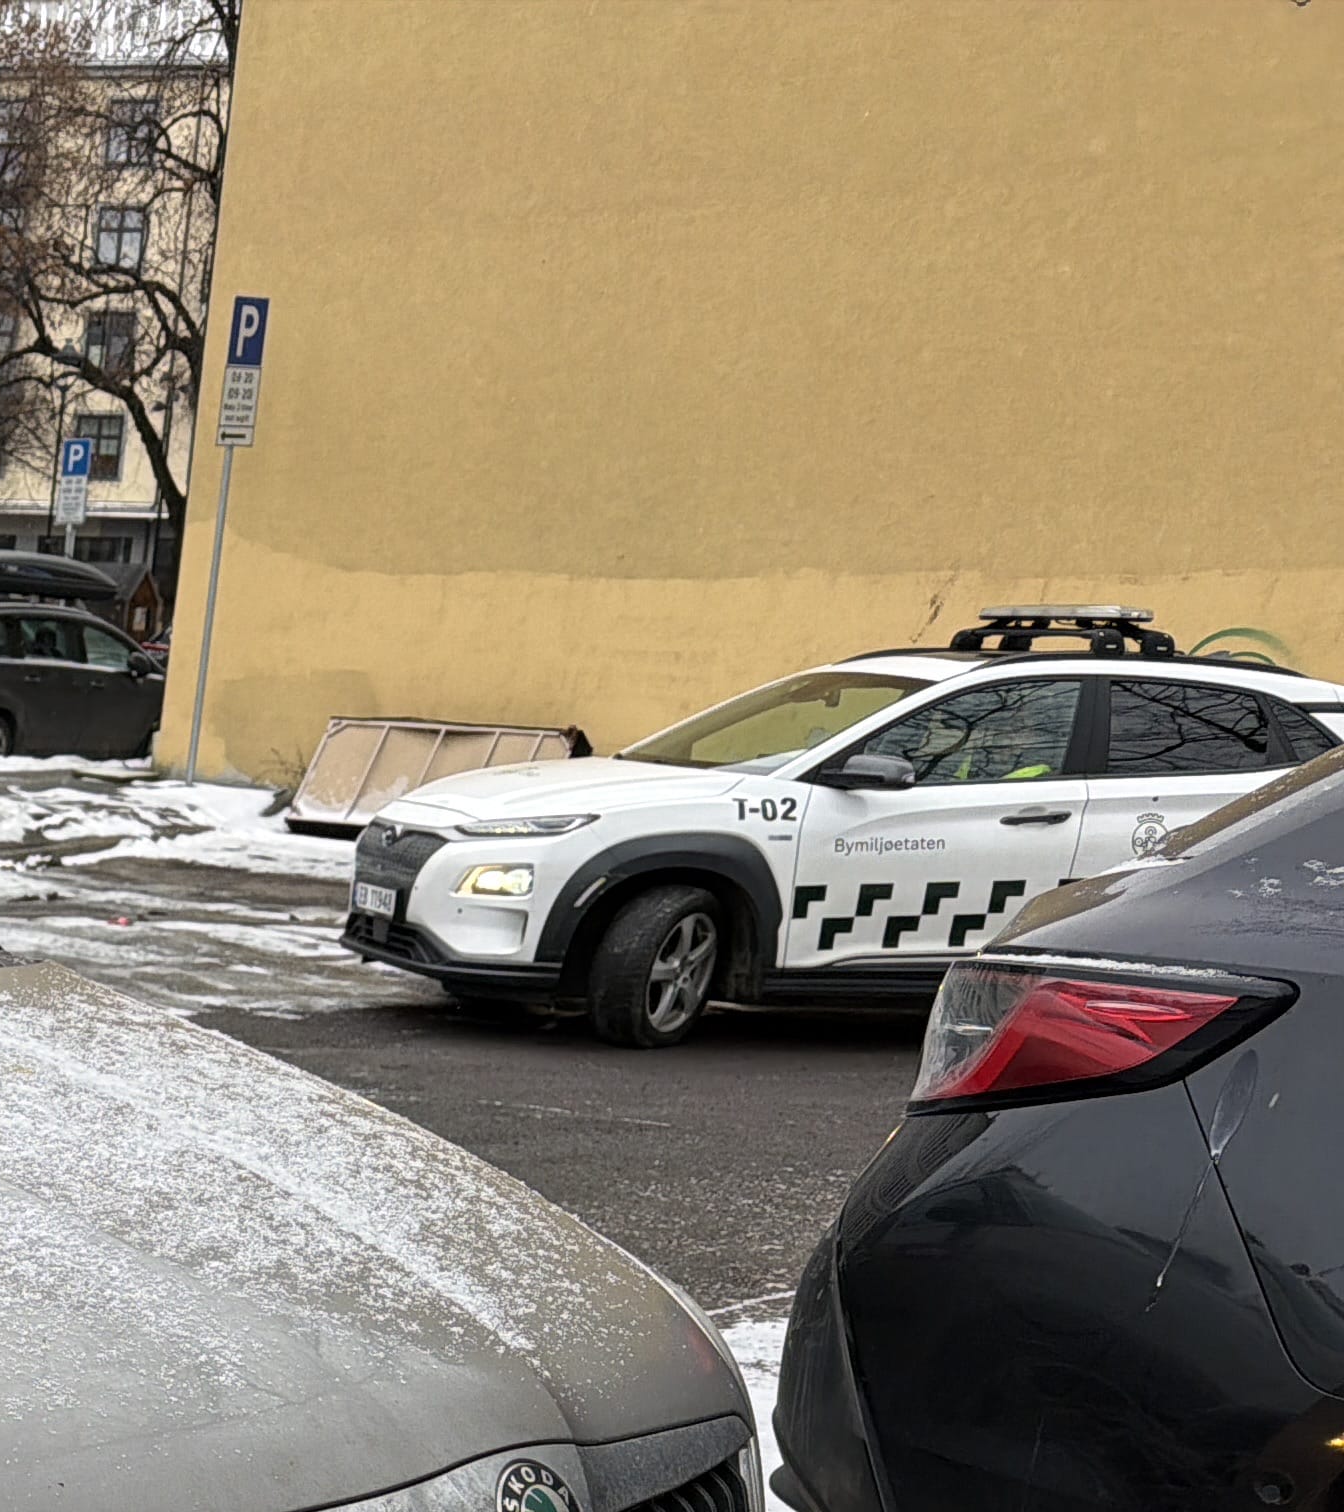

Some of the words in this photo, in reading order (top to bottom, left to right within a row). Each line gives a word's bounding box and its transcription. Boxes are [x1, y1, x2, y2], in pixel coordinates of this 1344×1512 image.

[235, 304, 260, 358] P
[67, 443, 85, 473] P
[732, 797, 798, 822] T-02
[834, 836, 946, 855] Bymiljøetaten
